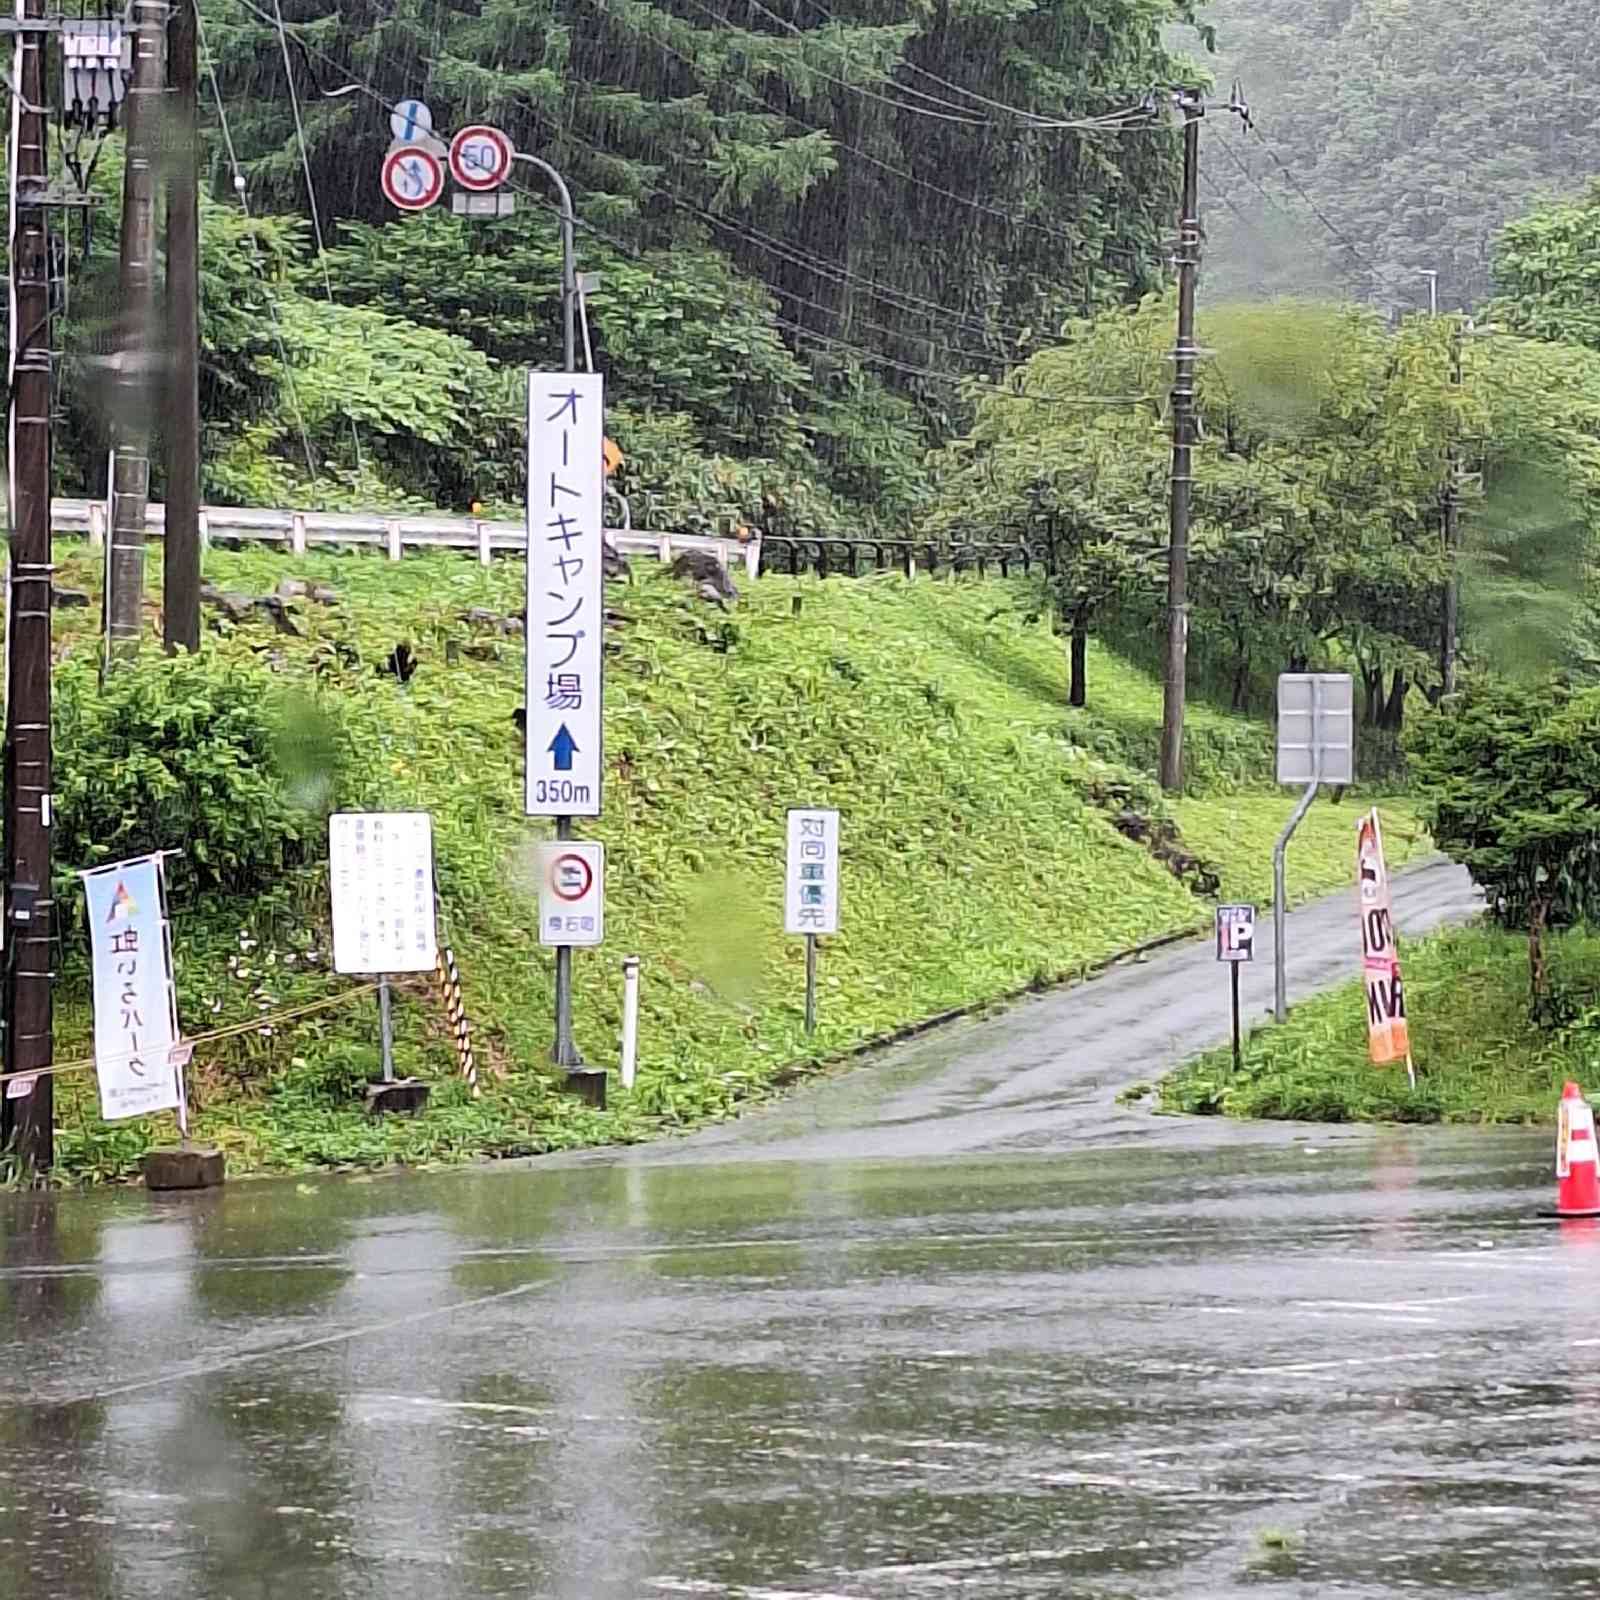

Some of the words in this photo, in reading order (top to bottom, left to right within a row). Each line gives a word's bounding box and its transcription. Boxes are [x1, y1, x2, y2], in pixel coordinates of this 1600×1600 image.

[464, 144, 496, 170] 50
[546, 388, 584, 710] オートキャンプ場
[536, 780, 590, 803] 350m
